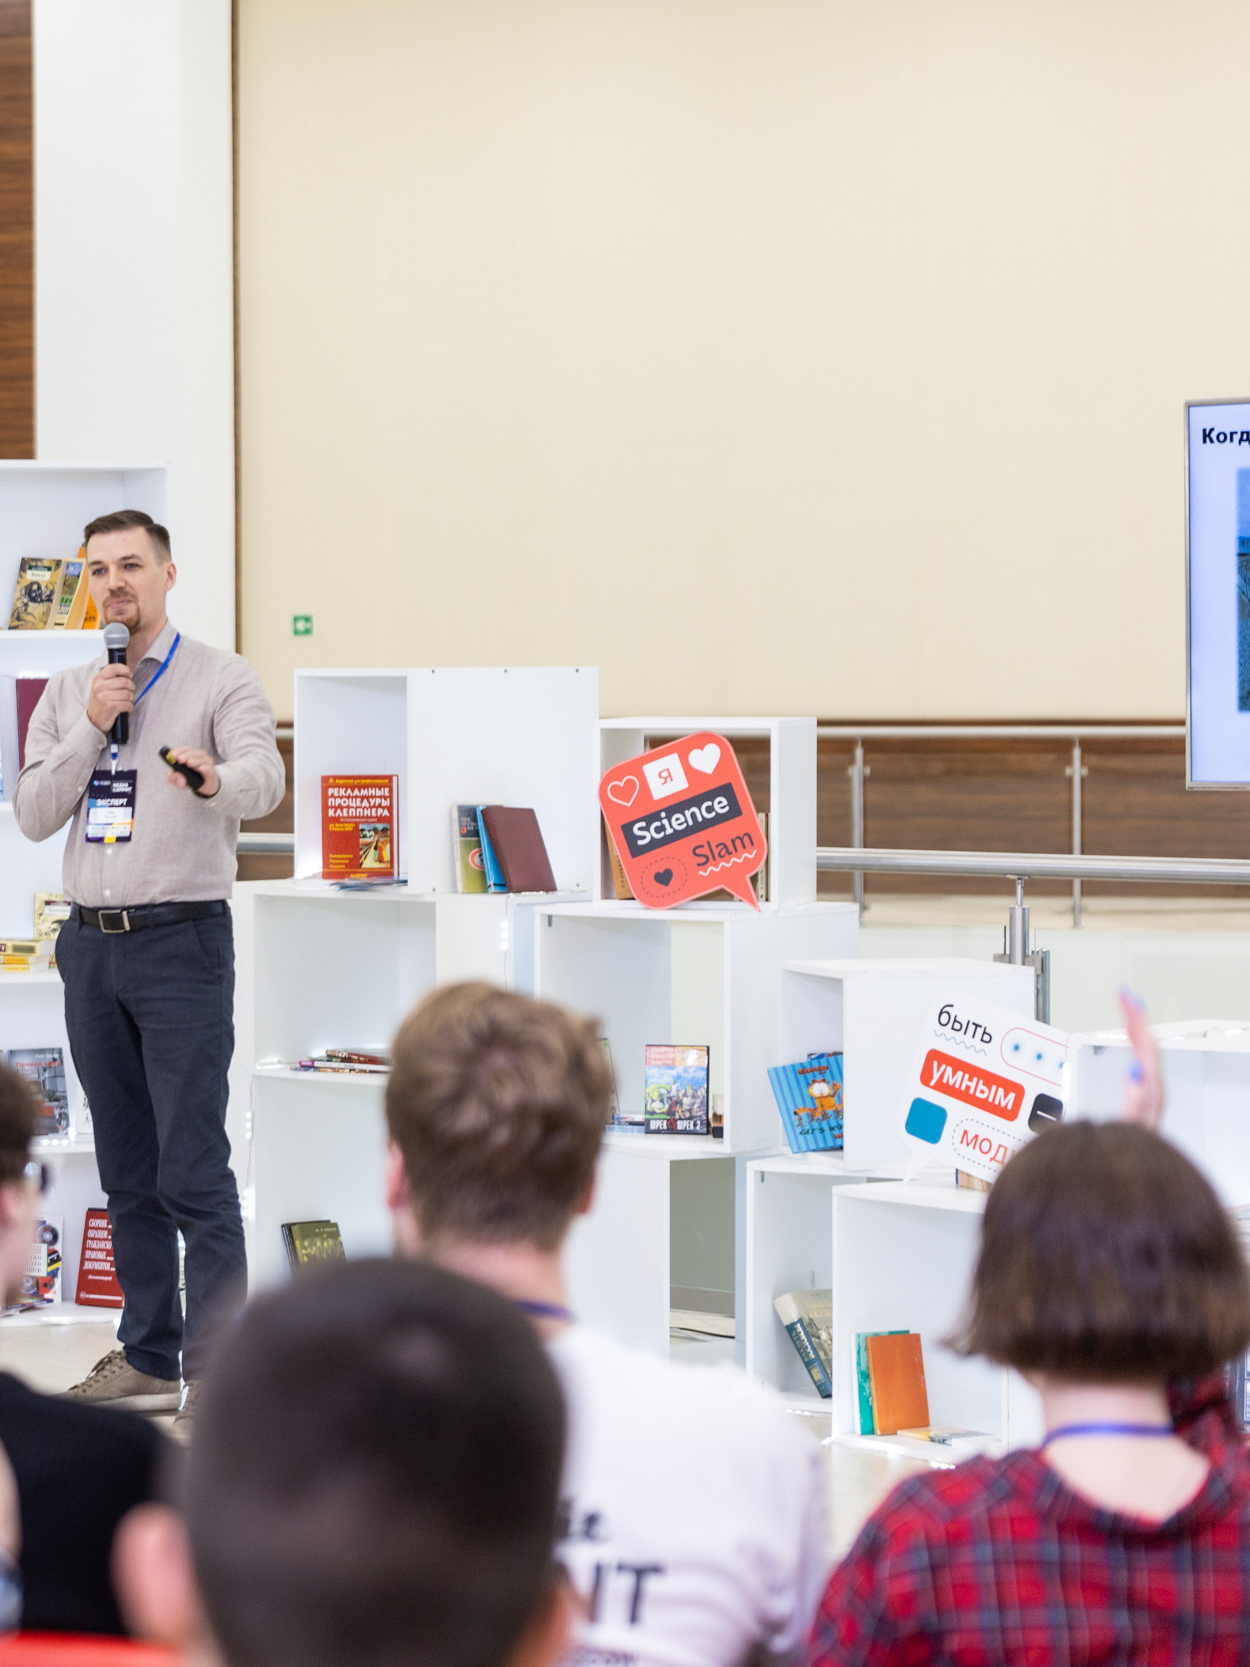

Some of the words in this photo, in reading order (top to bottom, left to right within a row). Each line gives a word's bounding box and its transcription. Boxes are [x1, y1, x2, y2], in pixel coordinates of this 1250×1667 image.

[657, 767, 674, 786] Я
[328, 787, 390, 797] РЕКЛАМНЫЕ
[96, 798, 128, 807] ЭКСПЕРТ
[328, 797, 390, 808] ПРОЦЕДУРЫ
[328, 808, 390, 817] КЛЕППНЕРА
[632, 796, 730, 846] Science
[692, 832, 755, 867] Slam
[937, 1004, 993, 1044] быть
[929, 1060, 1016, 1111] умным
[650, 1119, 668, 1130] ШРЕК
[676, 1119, 694, 1130] ШРЕК
[695, 1120, 701, 1130] 2
[960, 1129, 1017, 1167] мод
